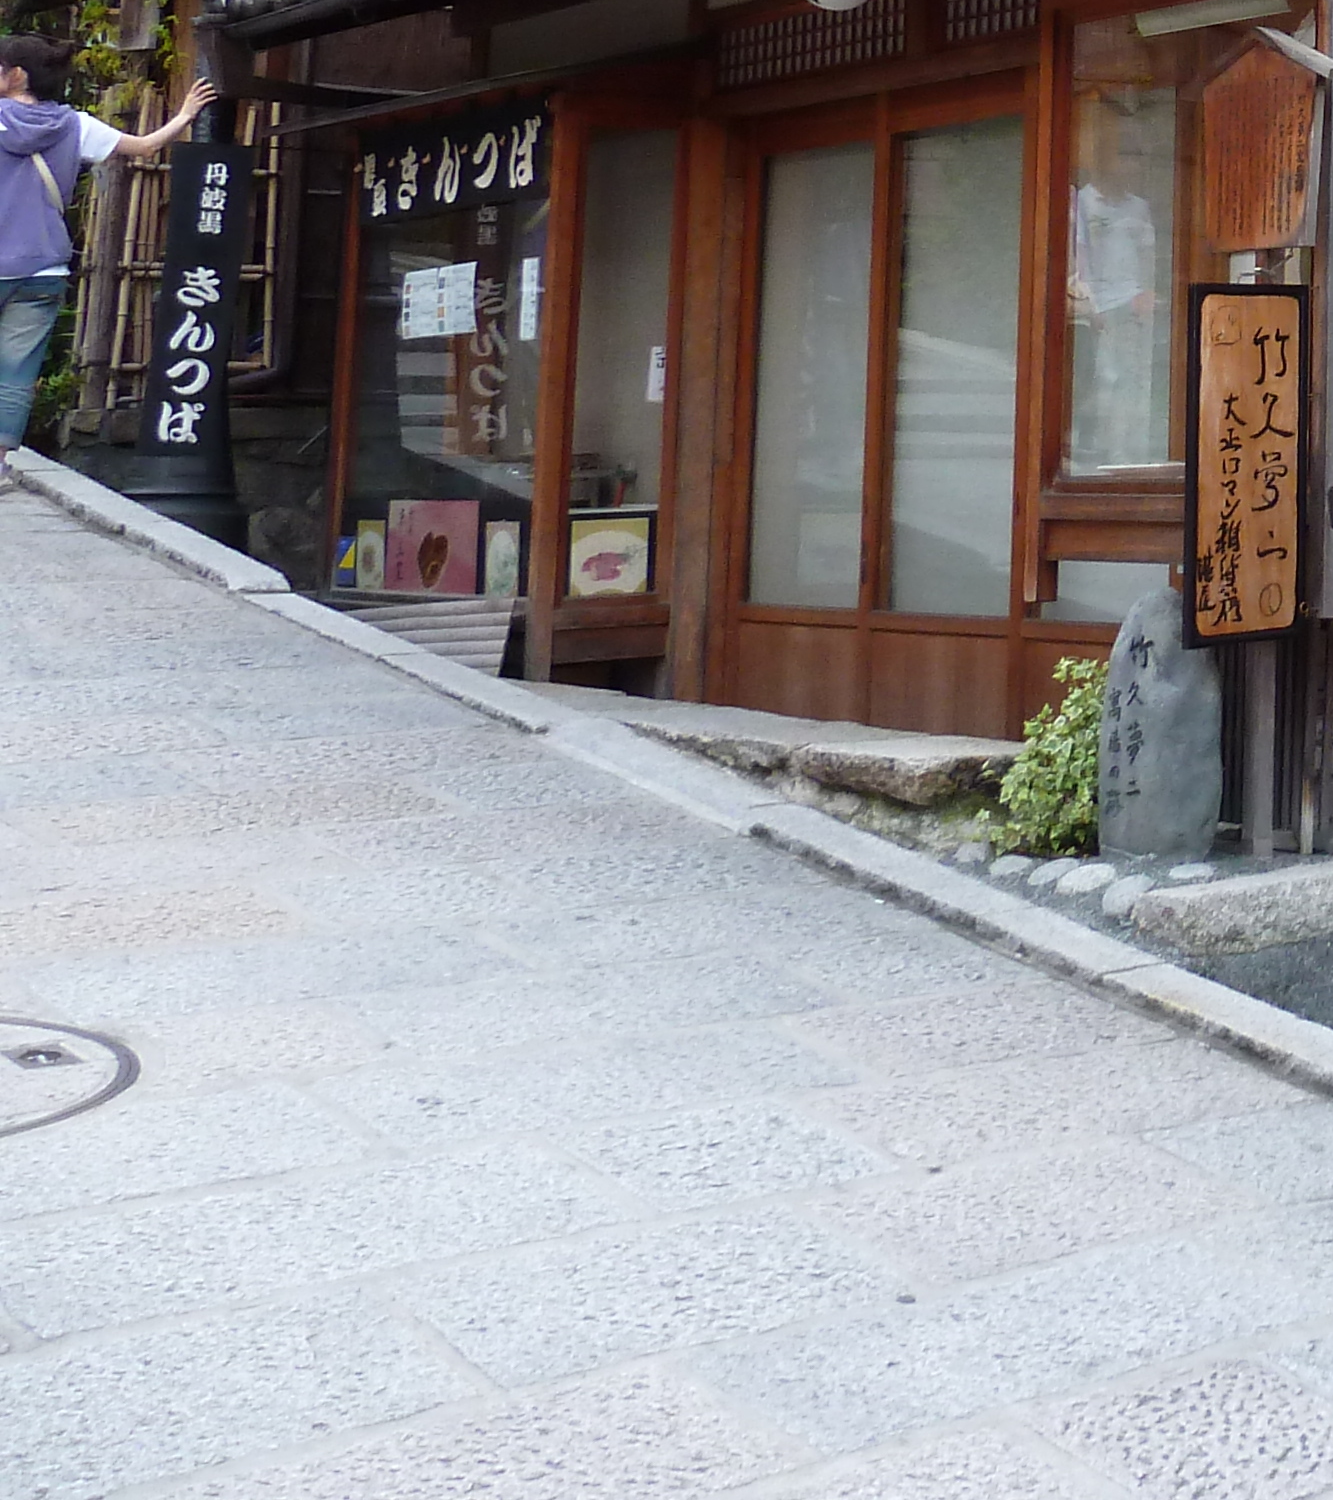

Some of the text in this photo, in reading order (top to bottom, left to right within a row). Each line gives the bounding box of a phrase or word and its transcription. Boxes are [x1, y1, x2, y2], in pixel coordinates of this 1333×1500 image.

[196, 162, 230, 235] 丹波黒
[1125, 634, 1155, 797] 竹久夢二
